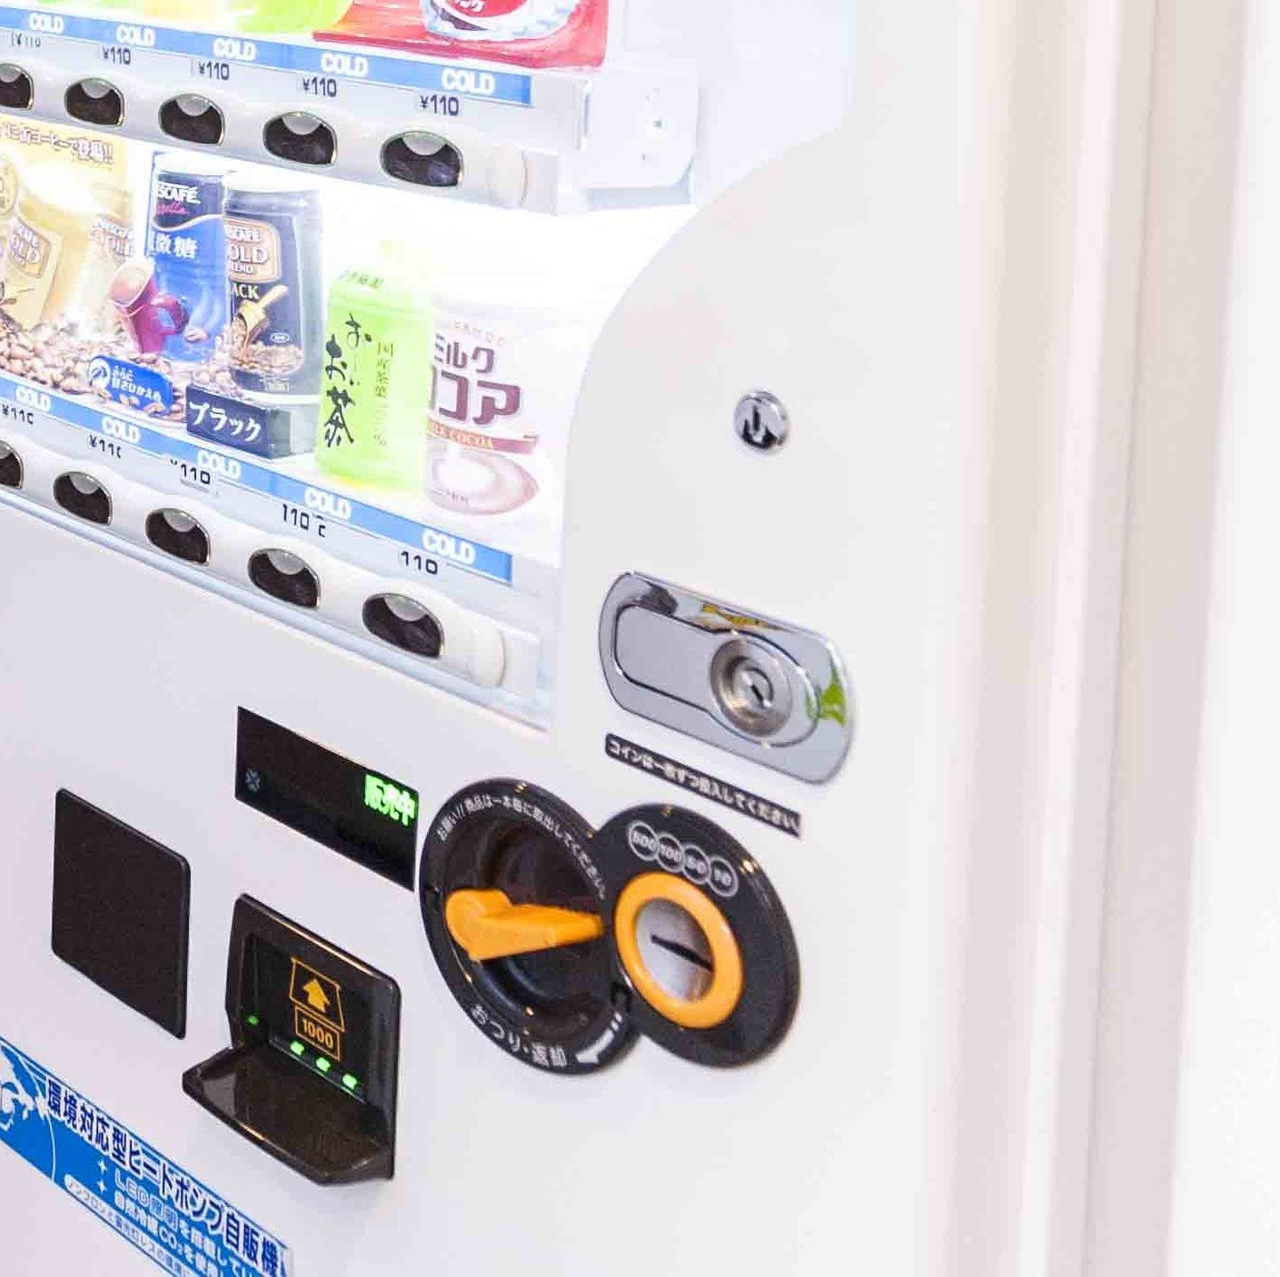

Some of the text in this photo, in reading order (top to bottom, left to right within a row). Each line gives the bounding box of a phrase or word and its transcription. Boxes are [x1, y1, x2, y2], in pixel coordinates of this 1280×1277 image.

[29, 13, 65, 33] COLD
[116, 24, 157, 46] COLD
[102, 45, 132, 66] ¥110
[213, 38, 257, 61] COLD
[198, 60, 231, 81] ¥110
[320, 53, 369, 78] COLD
[303, 77, 338, 98] ¥110
[441, 68, 496, 95] COLD
[420, 93, 461, 117] ¥110
[228, 243, 268, 264] OLD
[231, 283, 260, 301] ACK
[15, 385, 52, 412] COLD
[101, 414, 141, 442] COLD
[197, 450, 242, 482] COLD
[303, 487, 352, 520] COLD
[421, 530, 476, 564] COLD
[401, 550, 439, 576] 110
[302, 1018, 334, 1050] 1000
[45, 1076, 280, 1276] 環境対応型ヒートポンプ自販機
